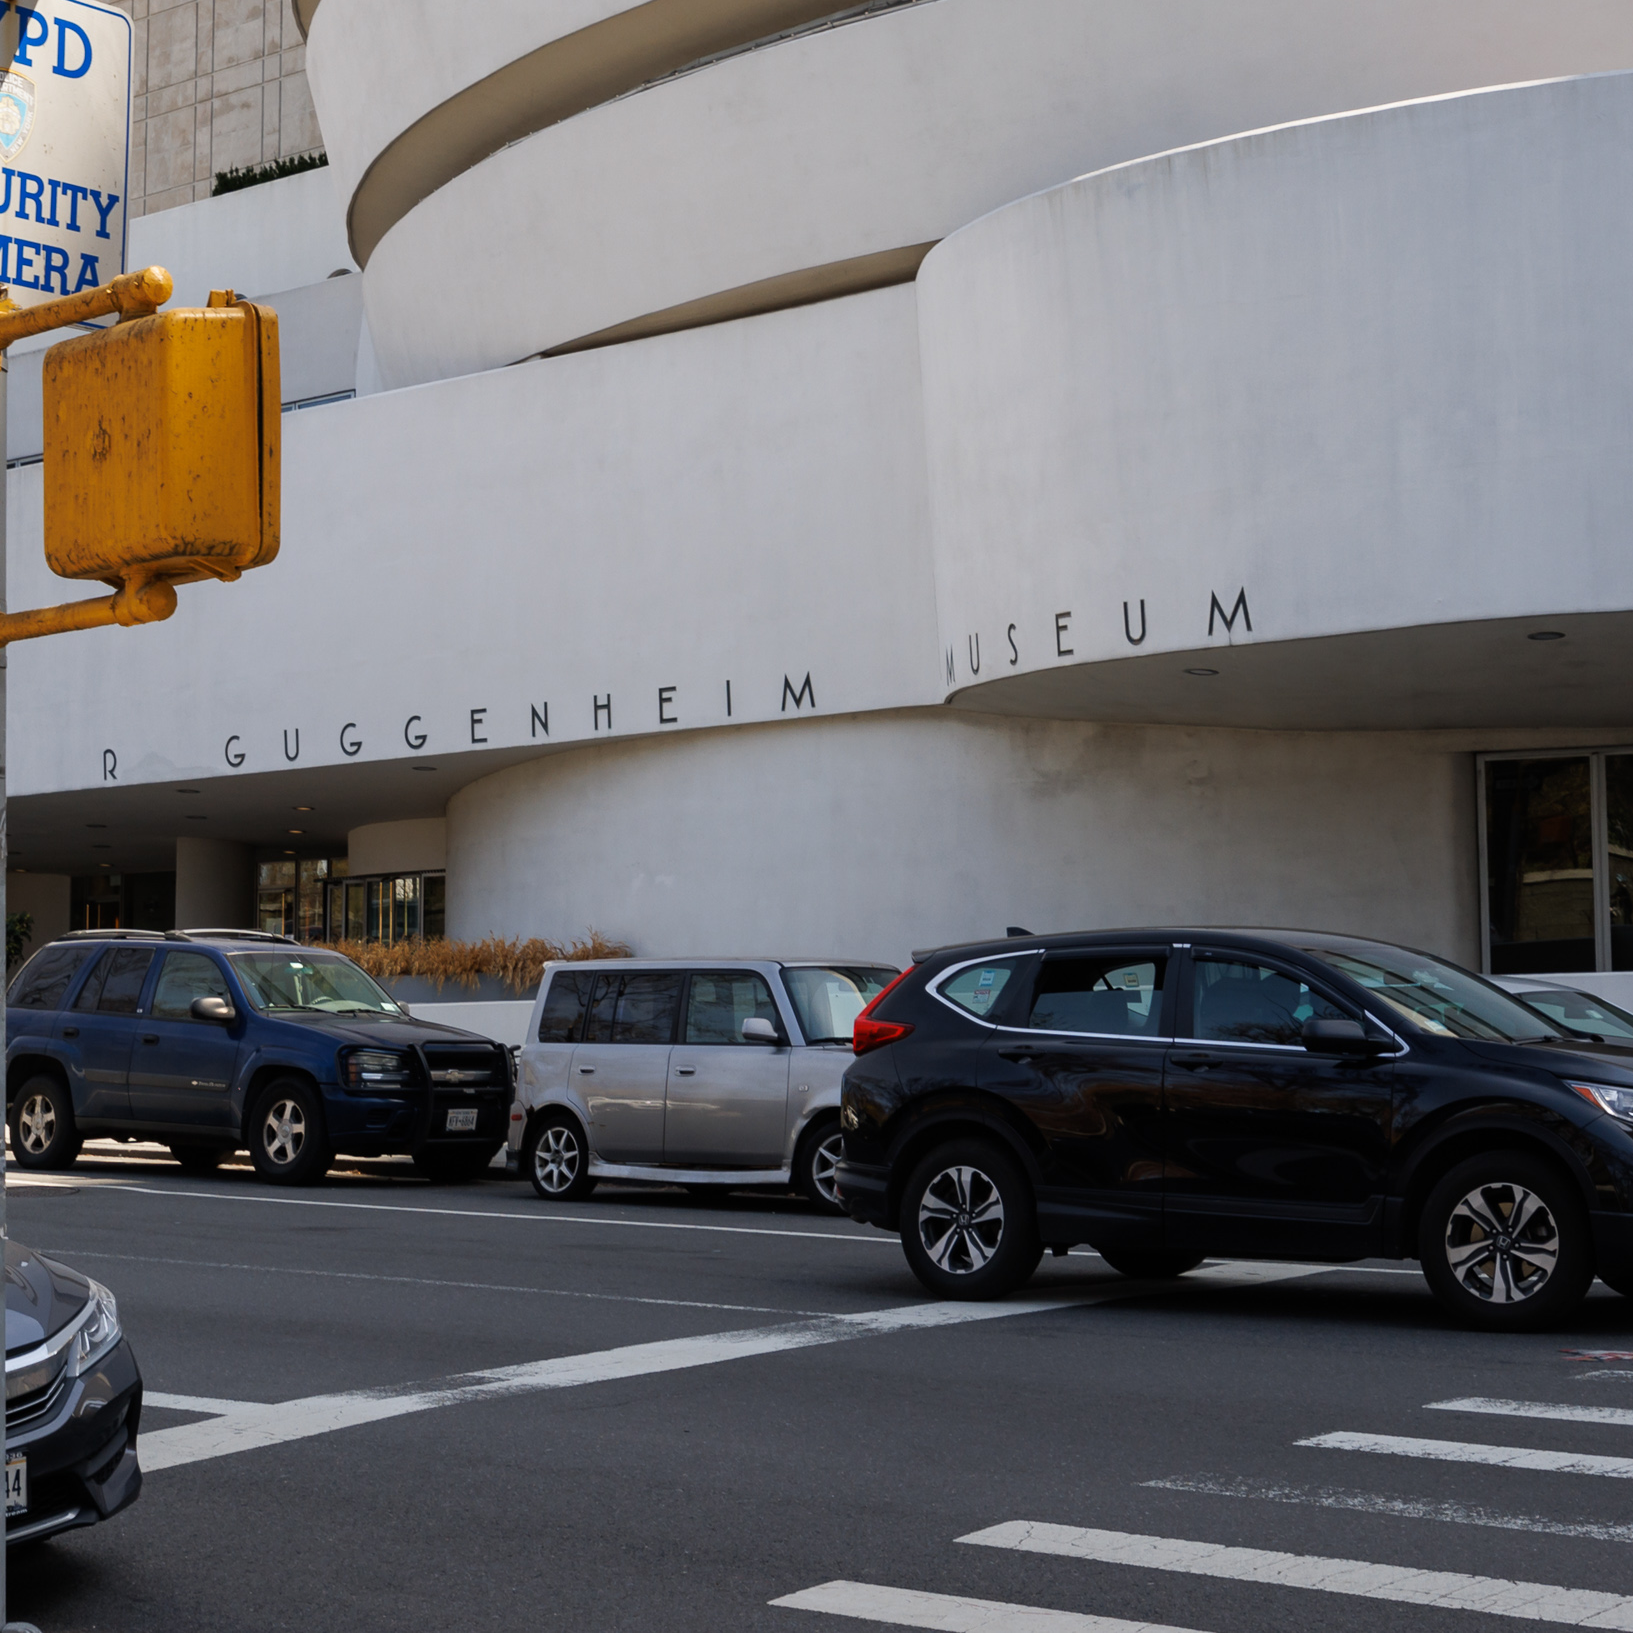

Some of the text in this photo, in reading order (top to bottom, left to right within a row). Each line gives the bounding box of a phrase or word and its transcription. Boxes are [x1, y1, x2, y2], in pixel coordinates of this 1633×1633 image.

[10, 136, 24, 154] NEW
[22, 111, 34, 134] YORK
[103, 748, 117, 781] R
[225, 671, 816, 768] GUGGENHEIM
[945, 585, 1253, 687] MUSEUM
